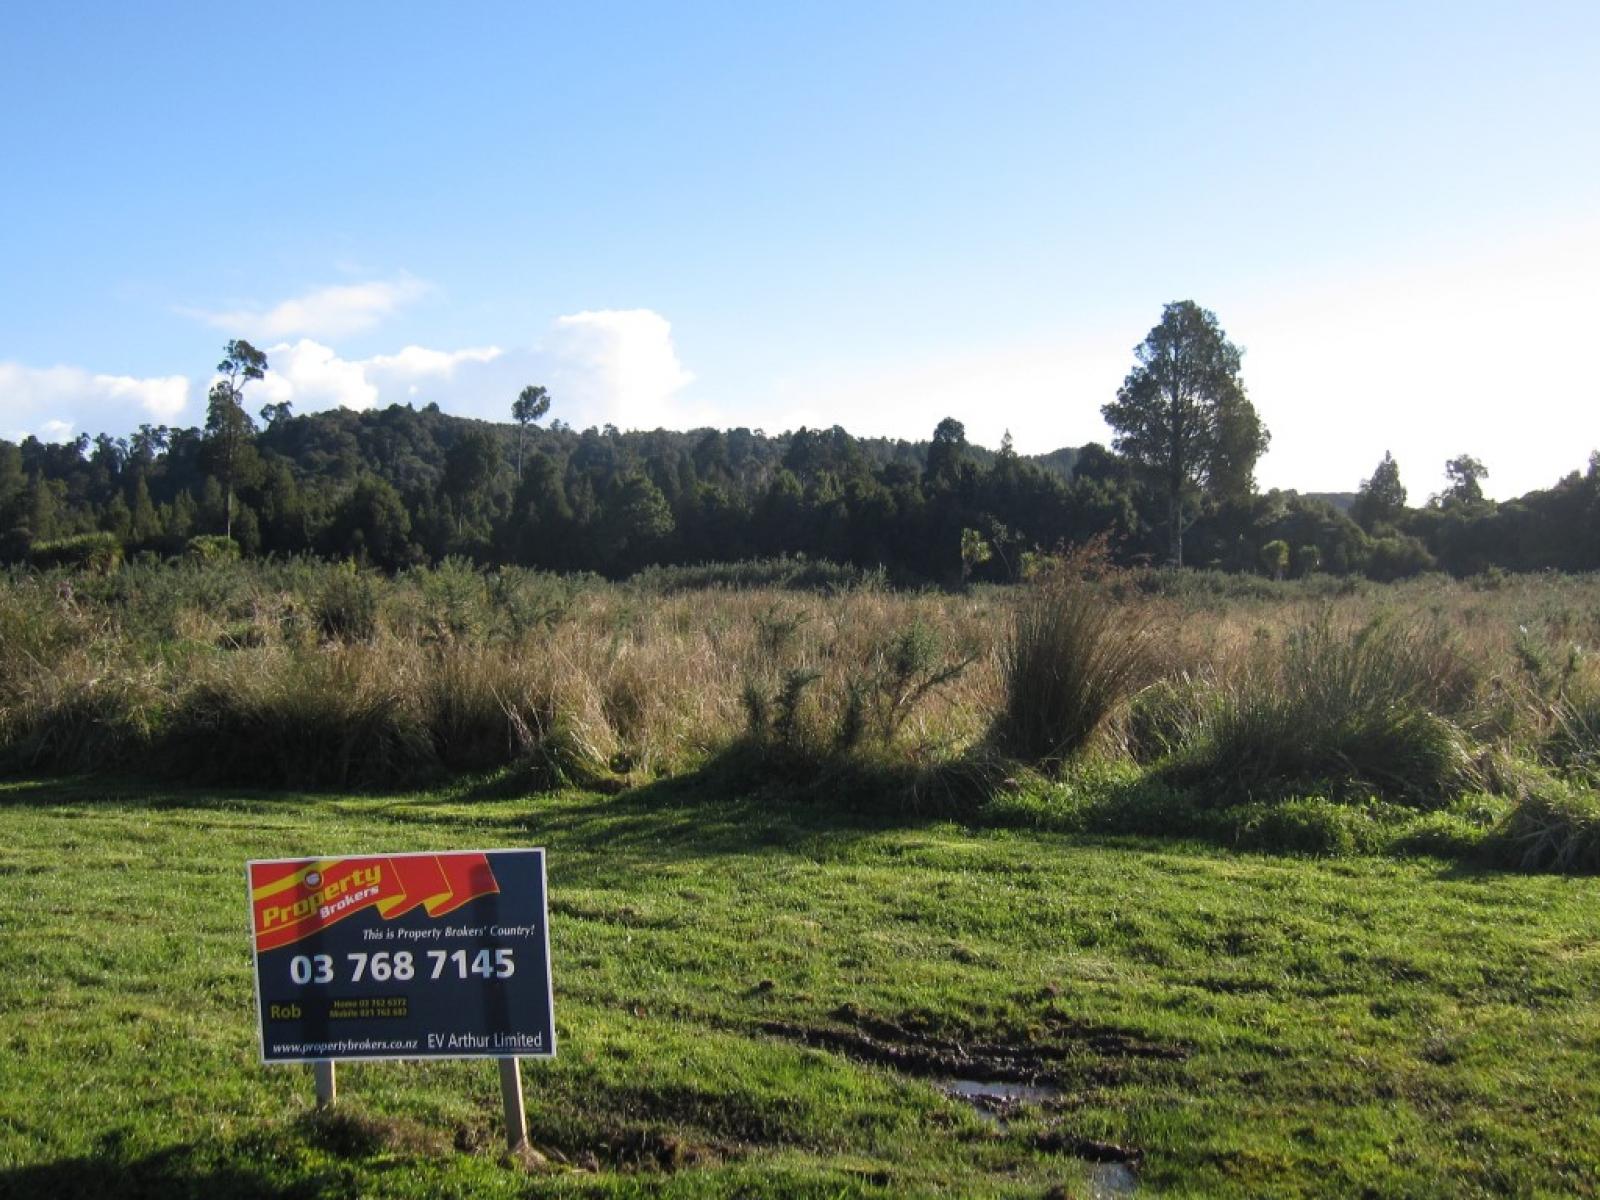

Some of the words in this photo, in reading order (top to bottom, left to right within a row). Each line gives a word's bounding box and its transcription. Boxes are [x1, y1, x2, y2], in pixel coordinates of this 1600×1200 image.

[262, 865, 381, 929] Property
[320, 885, 379, 920] Brokers
[363, 928, 383, 941] This
[385, 927, 395, 940] is
[397, 926, 441, 942] Property
[445, 925, 487, 938] Brokers'
[490, 924, 536, 939] Country!
[290, 954, 334, 985] 03
[347, 950, 415, 983] 768
[427, 948, 515, 980] 7145
[271, 1003, 301, 1019] Rob
[273, 1038, 418, 1055] www.propertybrokers.co.nz
[427, 1033, 445, 1049] EV
[448, 1031, 490, 1049] Arthur
[494, 1031, 543, 1048] Limited
